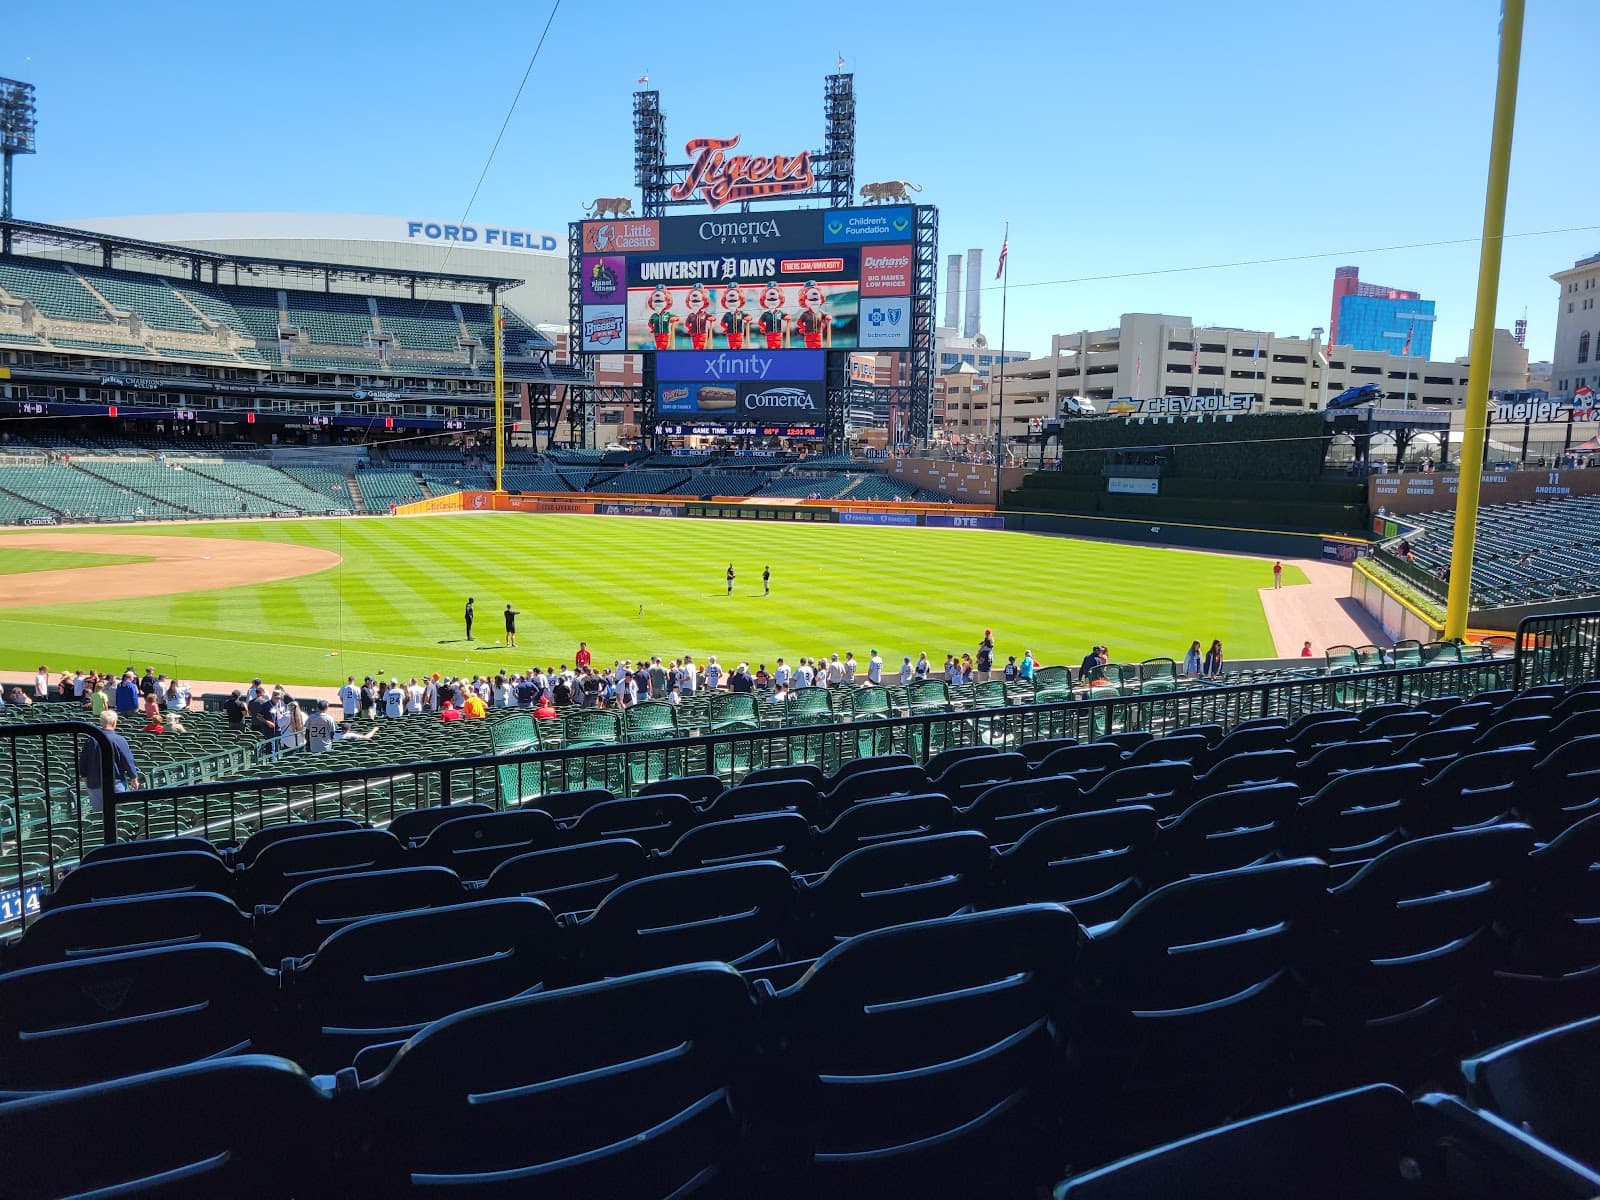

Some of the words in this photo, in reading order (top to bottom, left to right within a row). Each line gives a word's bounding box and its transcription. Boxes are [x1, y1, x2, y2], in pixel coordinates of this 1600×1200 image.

[671, 135, 815, 211] Tigers
[849, 217, 886, 226] Children's
[623, 225, 652, 237] Little
[845, 225, 890, 235] Foundation
[407, 222, 478, 242] FORD
[485, 228, 557, 251] FIELD
[615, 235, 656, 248] Caesars
[721, 235, 759, 244] PARK
[864, 256, 909, 267] Dunham's
[641, 260, 719, 280] UNIVERSITY
[740, 258, 776, 277] DAYS
[591, 280, 612, 288] planet
[704, 353, 773, 379] xfinity
[126, 378, 162, 387] CHAMPIONS
[368, 391, 401, 399] Gallagher
[1141, 393, 1255, 413] CHEVROLET
[1495, 398, 1562, 423] meijer
[1125, 415, 1233, 425] FOUNTAIN
[805, 428, 816, 436] PM
[954, 517, 978, 526] DTE
[389, 697, 400, 705] 24
[312, 728, 327, 738] 24
[2, 893, 40, 918] 114
